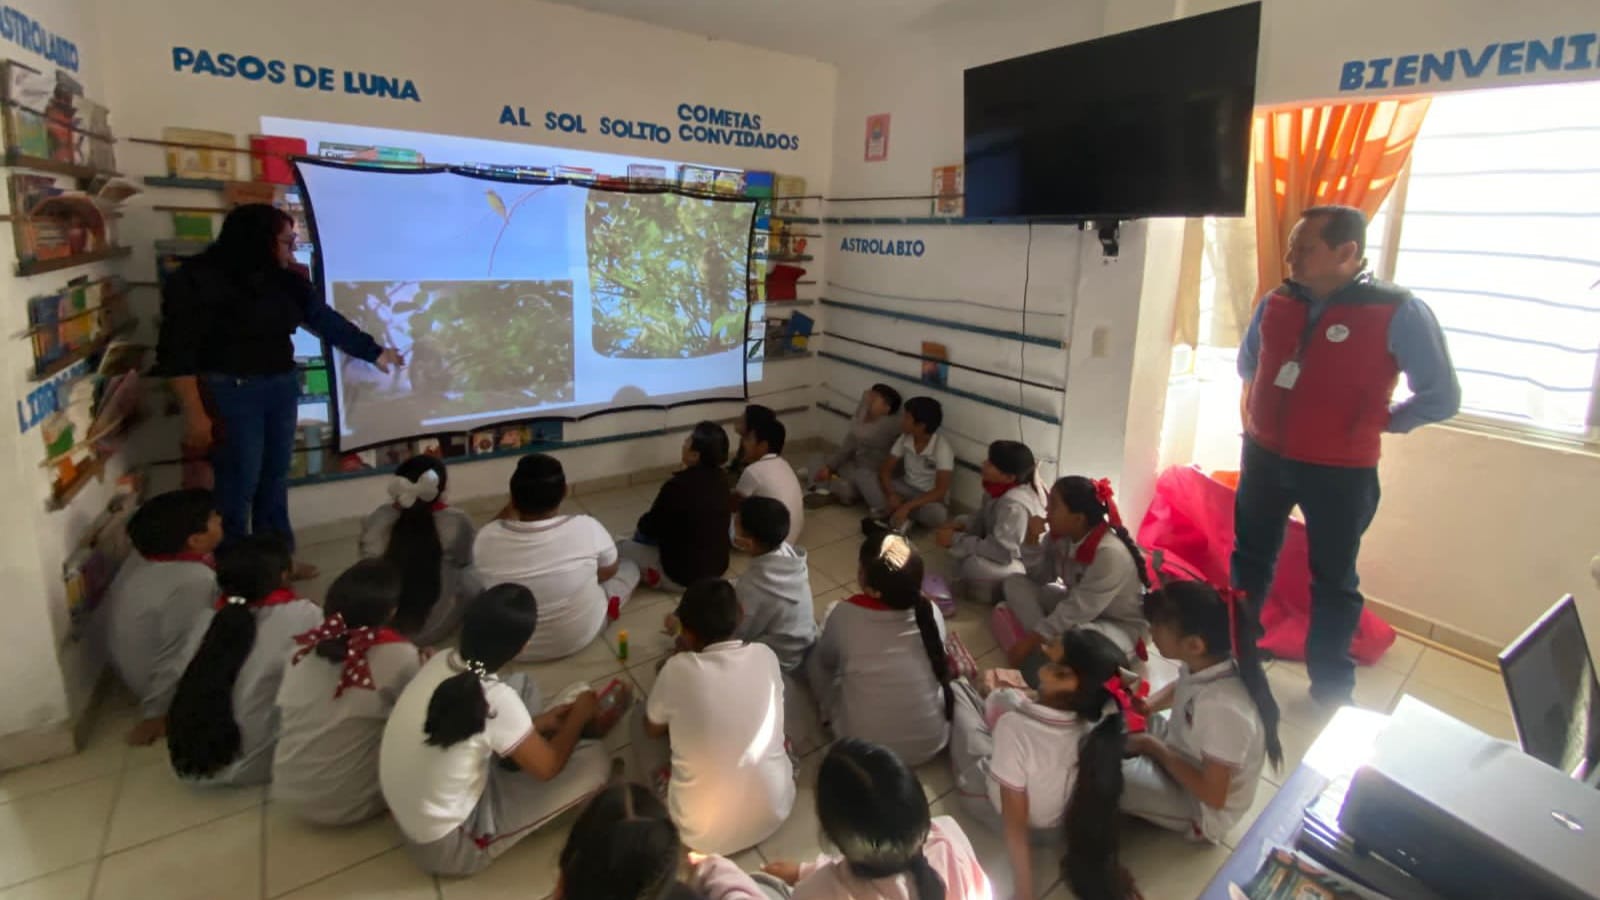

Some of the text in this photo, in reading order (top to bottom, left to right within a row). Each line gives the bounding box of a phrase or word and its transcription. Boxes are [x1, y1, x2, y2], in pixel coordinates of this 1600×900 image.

[172, 47, 420, 102] PASOS DE LUNA
[1339, 32, 1600, 91] BIENVENI
[499, 105, 672, 144] AL SOL SOLITO
[677, 103, 761, 130] COMETAS
[679, 124, 799, 151] CONVIDADOS
[839, 237, 926, 258] ASTROLABIO
